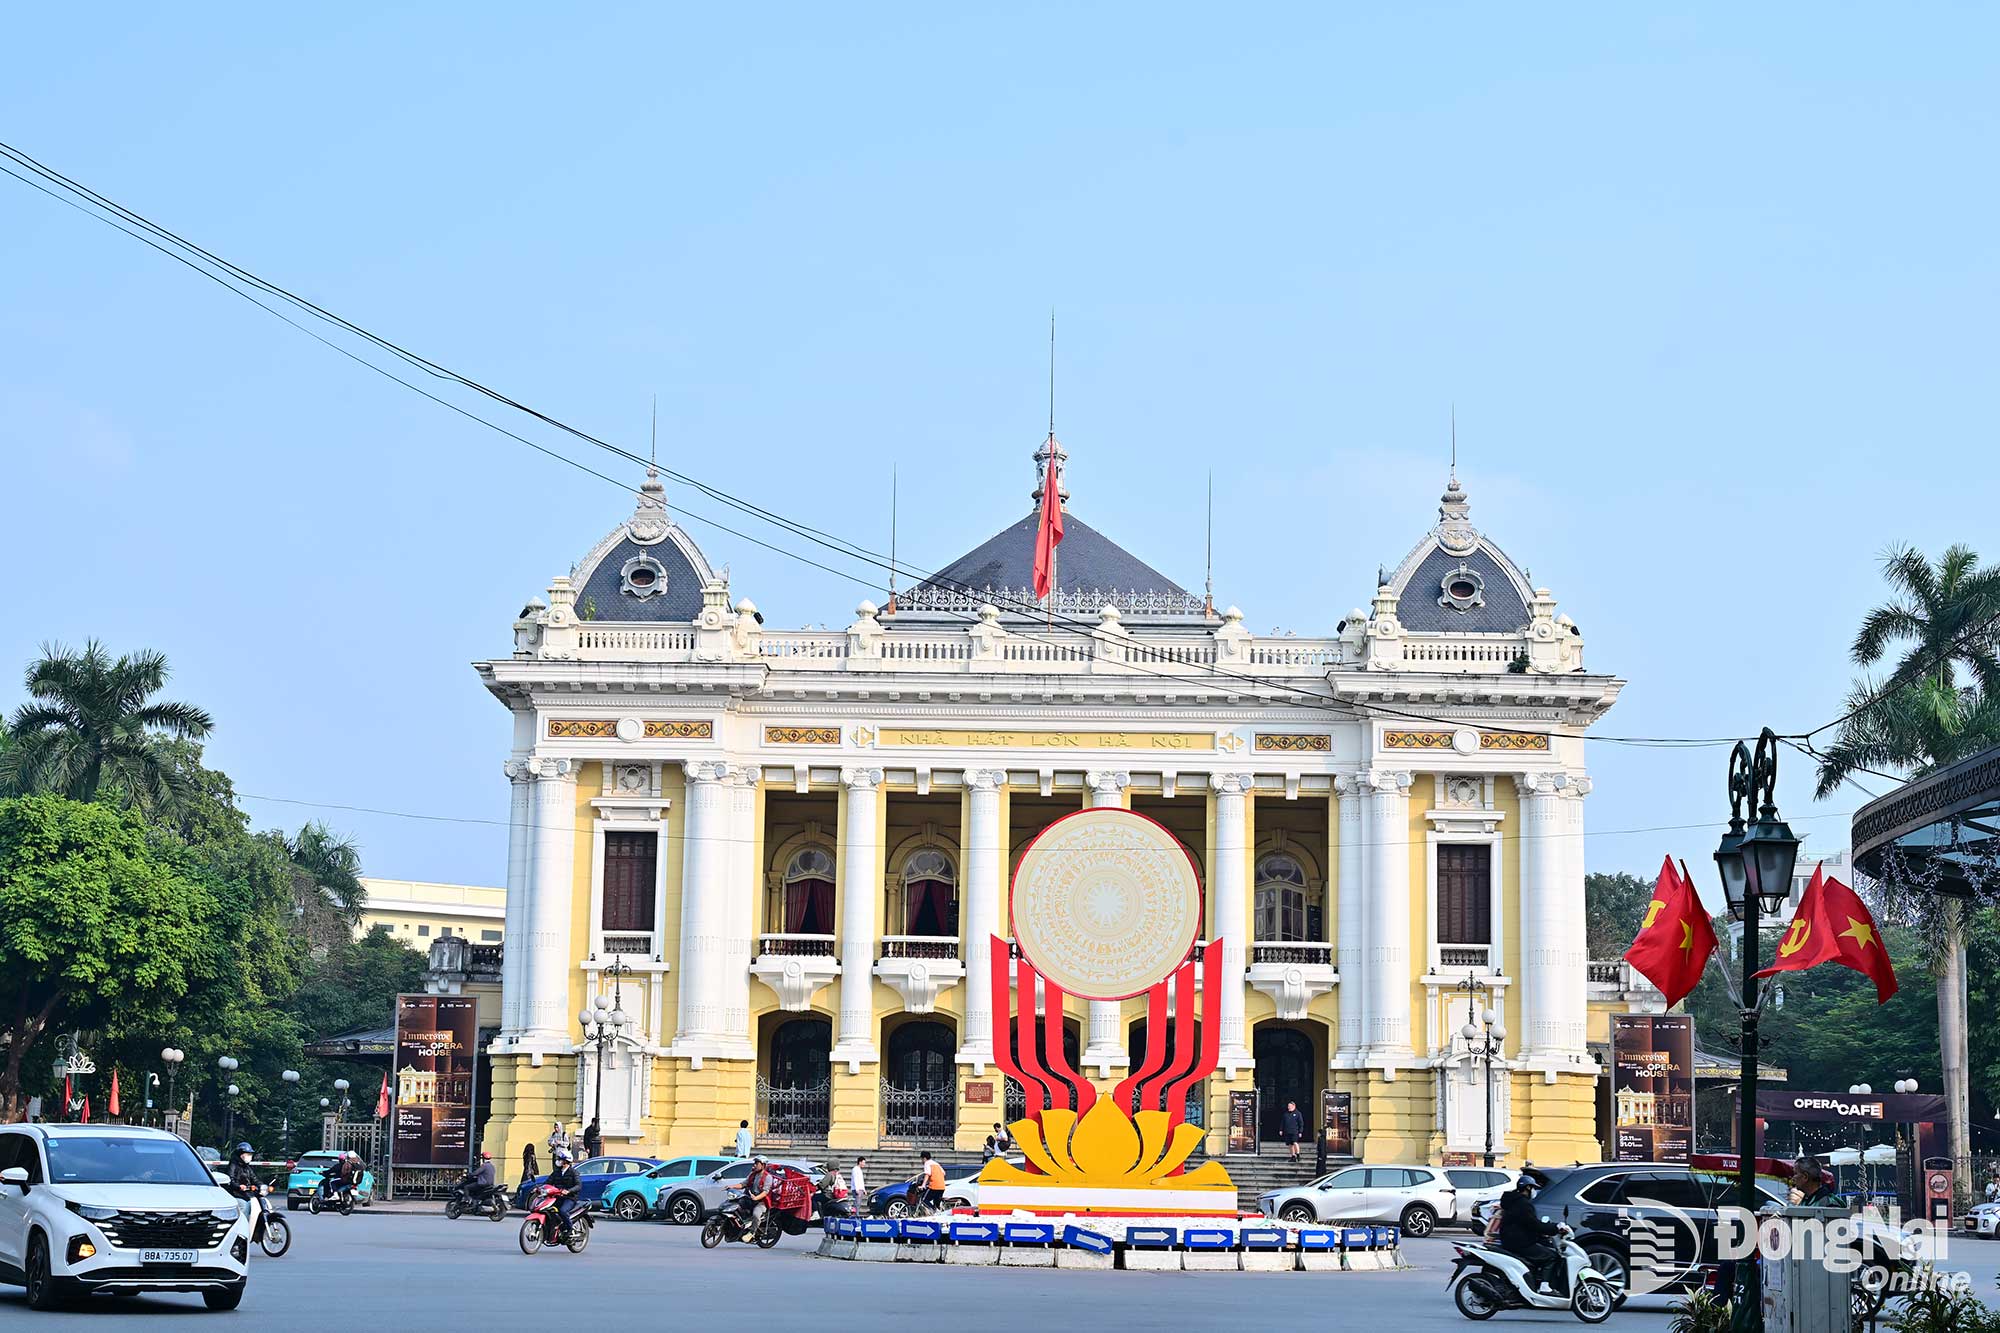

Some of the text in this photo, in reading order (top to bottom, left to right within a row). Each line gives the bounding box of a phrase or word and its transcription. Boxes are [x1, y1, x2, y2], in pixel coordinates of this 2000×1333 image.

[430, 1042, 464, 1050] OPERA
[418, 1049, 452, 1057] HOUSE
[1618, 1051, 1667, 1062] Immersive
[1646, 1063, 1681, 1071] OPERA
[1635, 1070, 1669, 1078] HOUSE
[1793, 1098, 1880, 1116] OPERA CAFE
